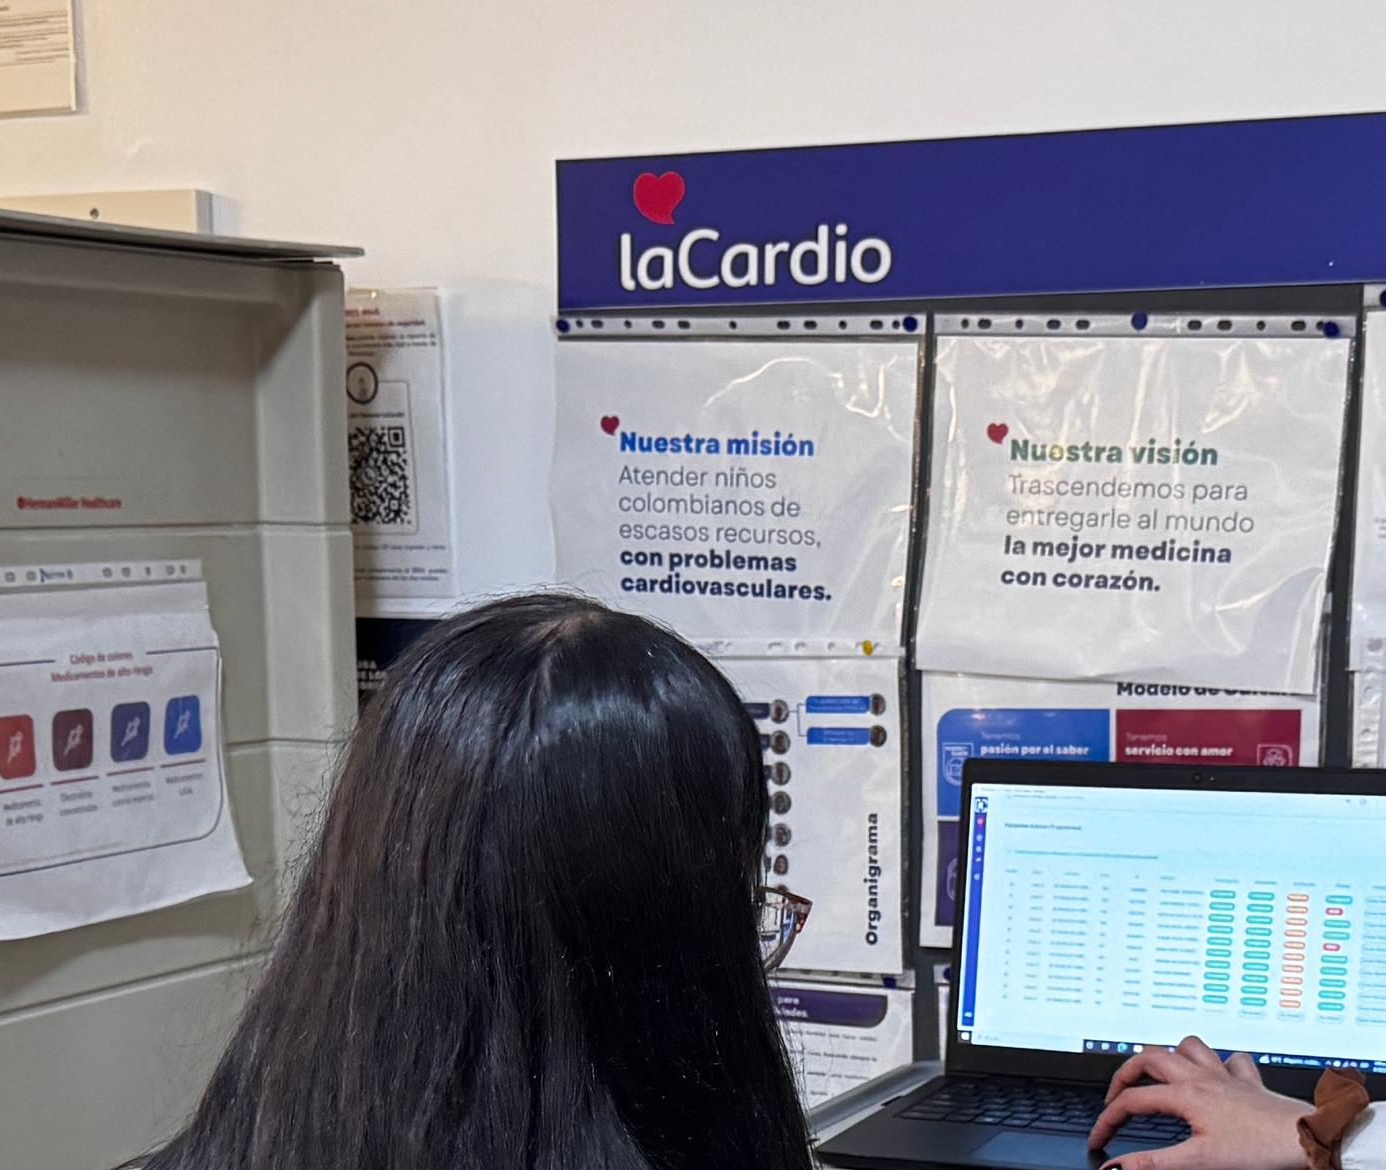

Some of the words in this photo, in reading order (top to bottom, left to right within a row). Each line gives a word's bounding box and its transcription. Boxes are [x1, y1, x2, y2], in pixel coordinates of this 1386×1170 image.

[619, 223, 893, 291] laCardio
[620, 431, 720, 454] Nuestra
[727, 431, 815, 456] misión
[1010, 440, 1122, 463] Nuestra
[1131, 438, 1218, 465] visión
[619, 465, 707, 487] Atender
[715, 467, 777, 488] niños
[1008, 474, 1184, 499] Trascendemos
[1192, 484, 1248, 504] para
[618, 493, 764, 516] colombianos
[771, 497, 801, 517] de
[1006, 508, 1131, 532] entregarle
[1137, 509, 1157, 530] al
[1165, 512, 1254, 534] mundo
[619, 523, 709, 542] escasos
[716, 526, 821, 548] recursos,
[620, 550, 663, 566] con
[669, 548, 797, 571] problemas
[1004, 535, 1026, 555] la
[1032, 535, 1106, 563] mejor
[1111, 539, 1232, 563] medicina
[621, 573, 832, 600] cardiovasculares.
[1001, 569, 1046, 586] con
[1052, 570, 1161, 592] corazón.
[980, 743, 1019, 757] pasión
[1022, 745, 1041, 757] por
[1043, 744, 1055, 756] el
[1056, 744, 1089, 757] saber
[1124, 744, 1174, 757] servicio
[1176, 747, 1199, 758] con
[1201, 747, 1233, 758] amor
[864, 812, 882, 946] Organigrama
